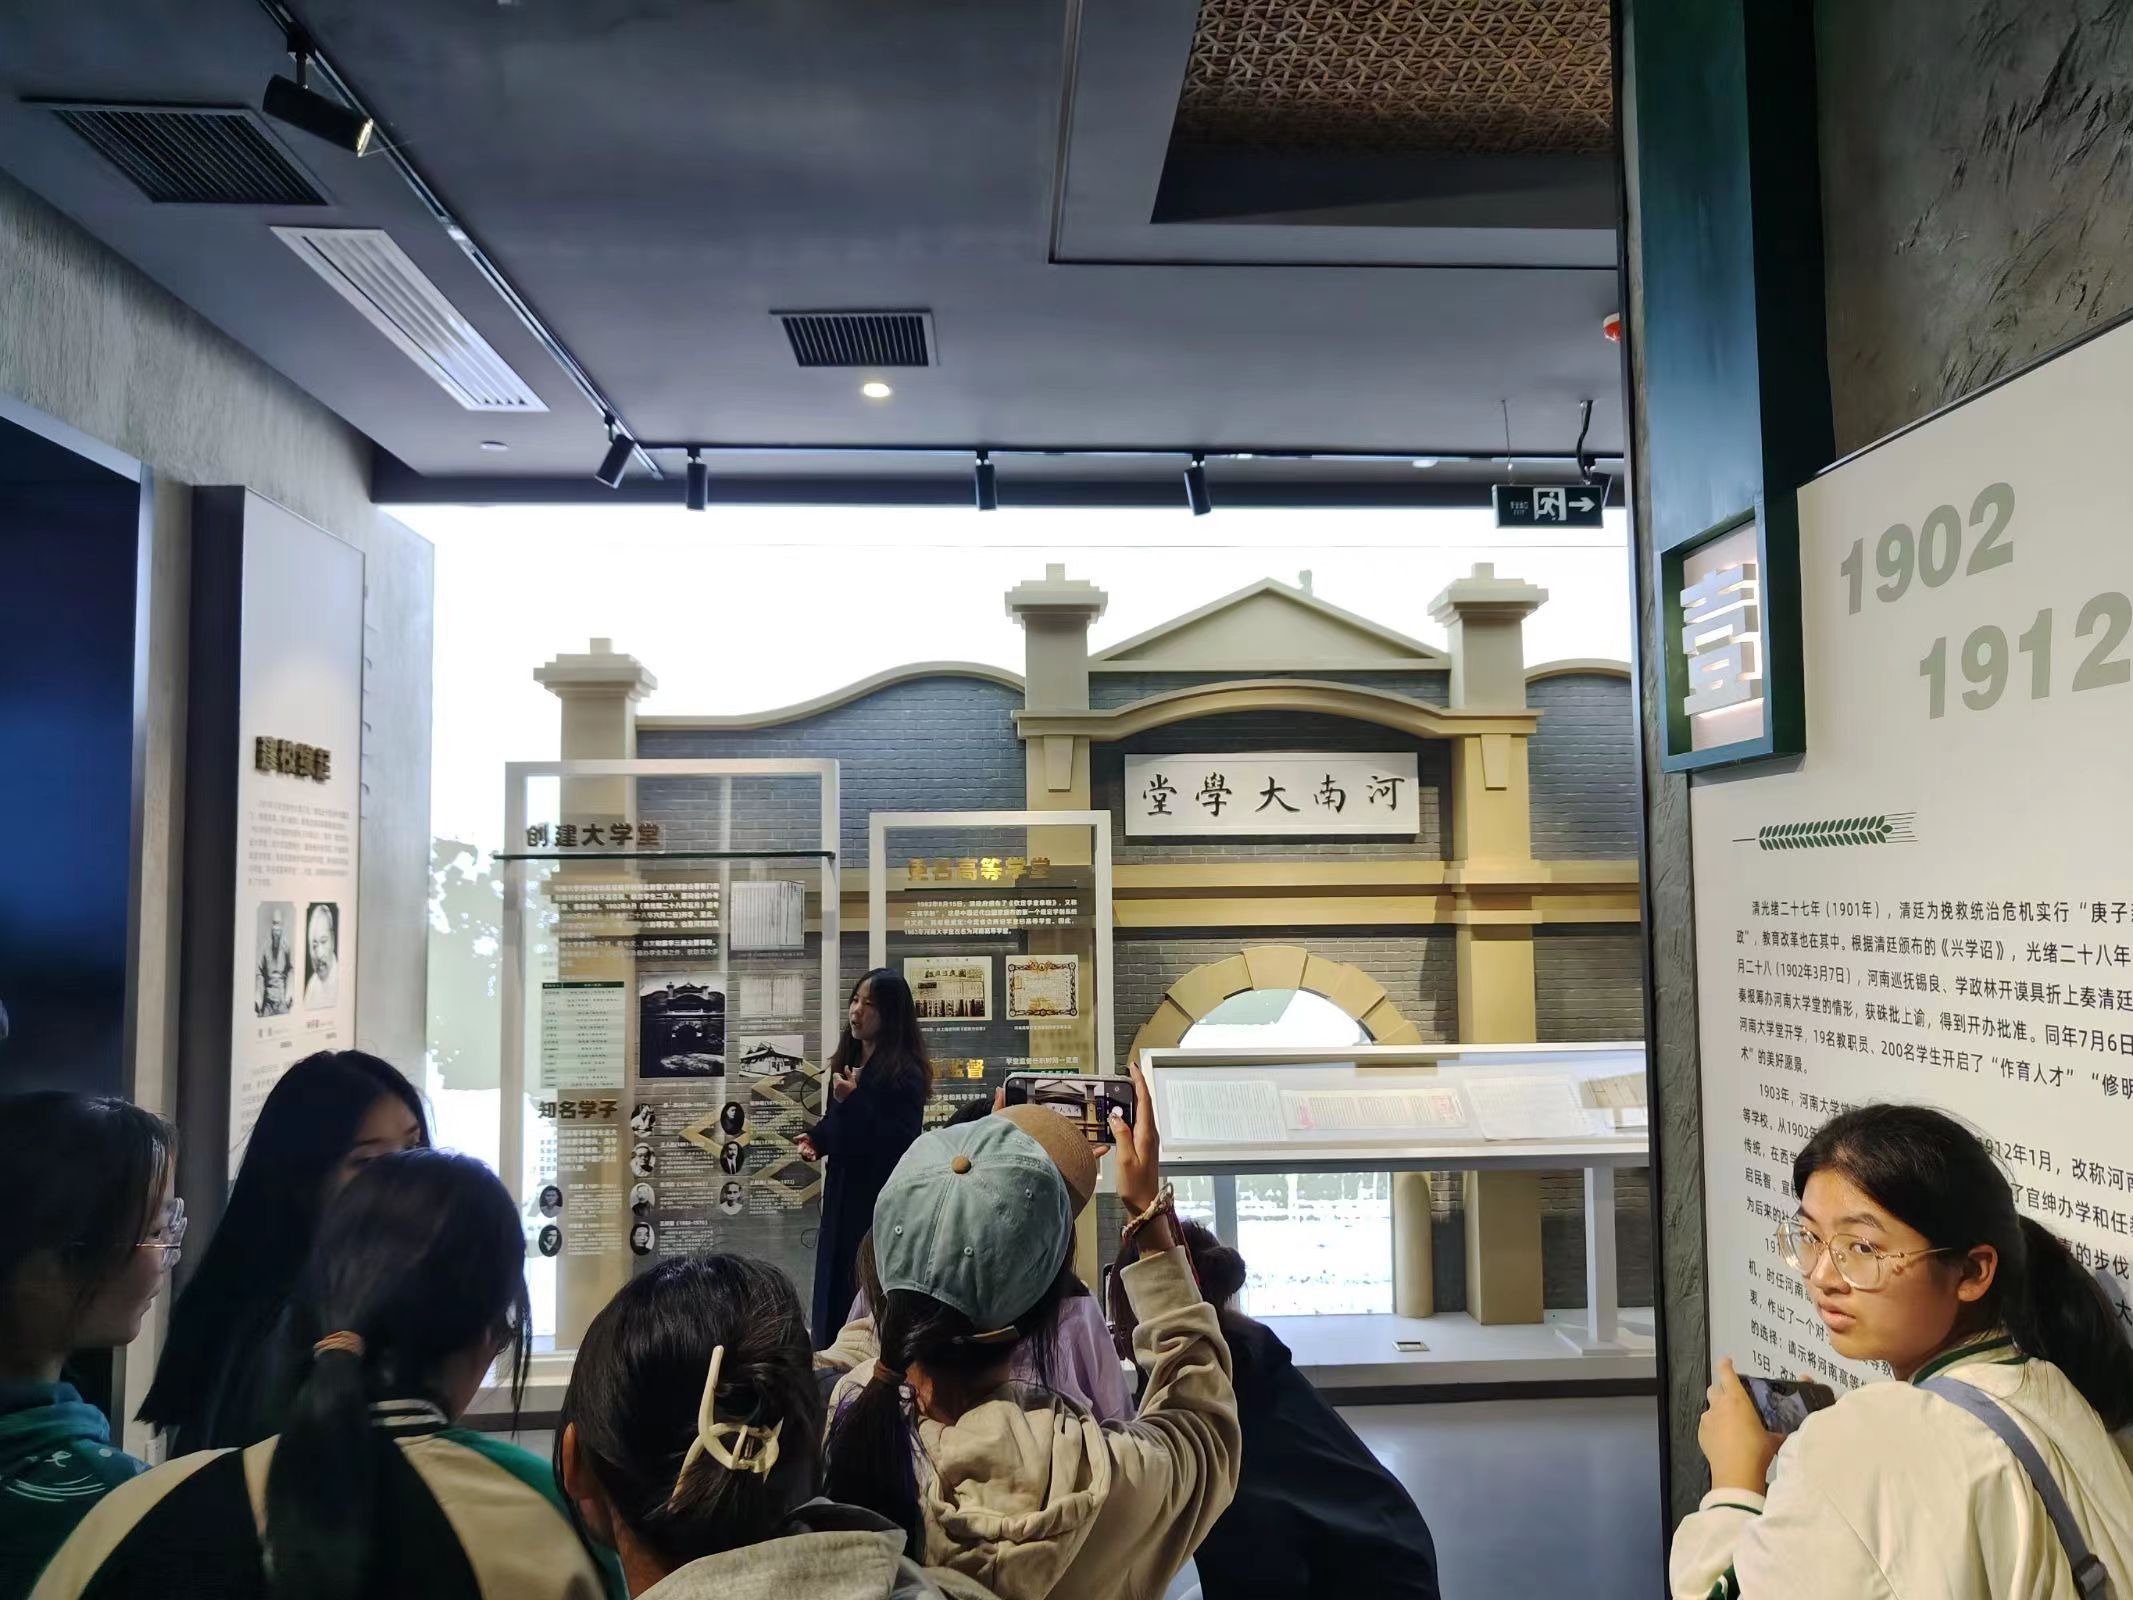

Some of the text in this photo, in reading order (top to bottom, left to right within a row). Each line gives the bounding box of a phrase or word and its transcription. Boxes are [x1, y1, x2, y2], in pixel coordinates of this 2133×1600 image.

[1840, 482, 2015, 615] 1902
[1920, 591, 2133, 719] 1912
[526, 823, 662, 847] 创建大学堂
[1752, 900, 2133, 923] 清光绪二十七年（1901年），清廷为挽救统治危机实行“庚子
[538, 1100, 618, 1119] 知名学子
